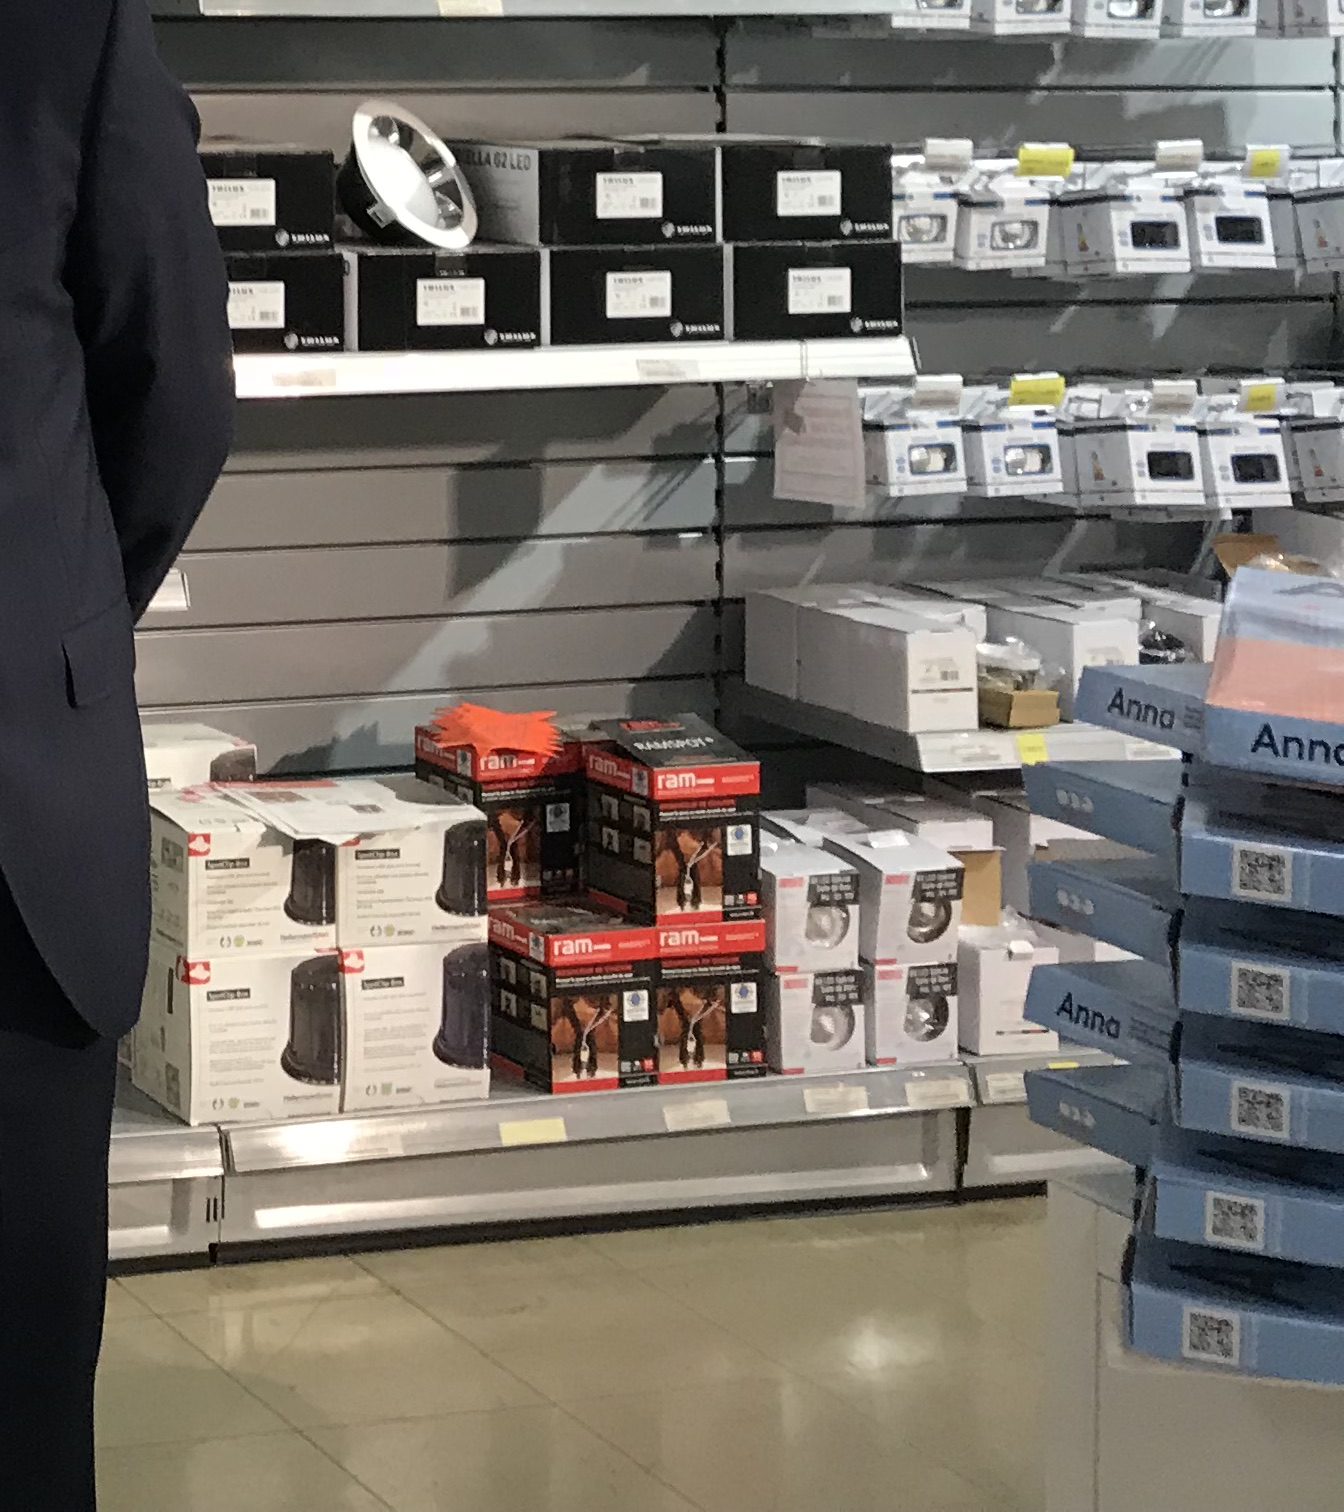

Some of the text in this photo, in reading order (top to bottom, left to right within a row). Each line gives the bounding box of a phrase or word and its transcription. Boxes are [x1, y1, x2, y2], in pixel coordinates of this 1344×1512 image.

[1107, 687, 1175, 730] Anna
[479, 753, 518, 771] ram
[589, 753, 617, 776] ram
[657, 771, 696, 789] ram
[553, 938, 593, 956] ram
[660, 930, 700, 947] ram
[1056, 992, 1121, 1040] Anna
